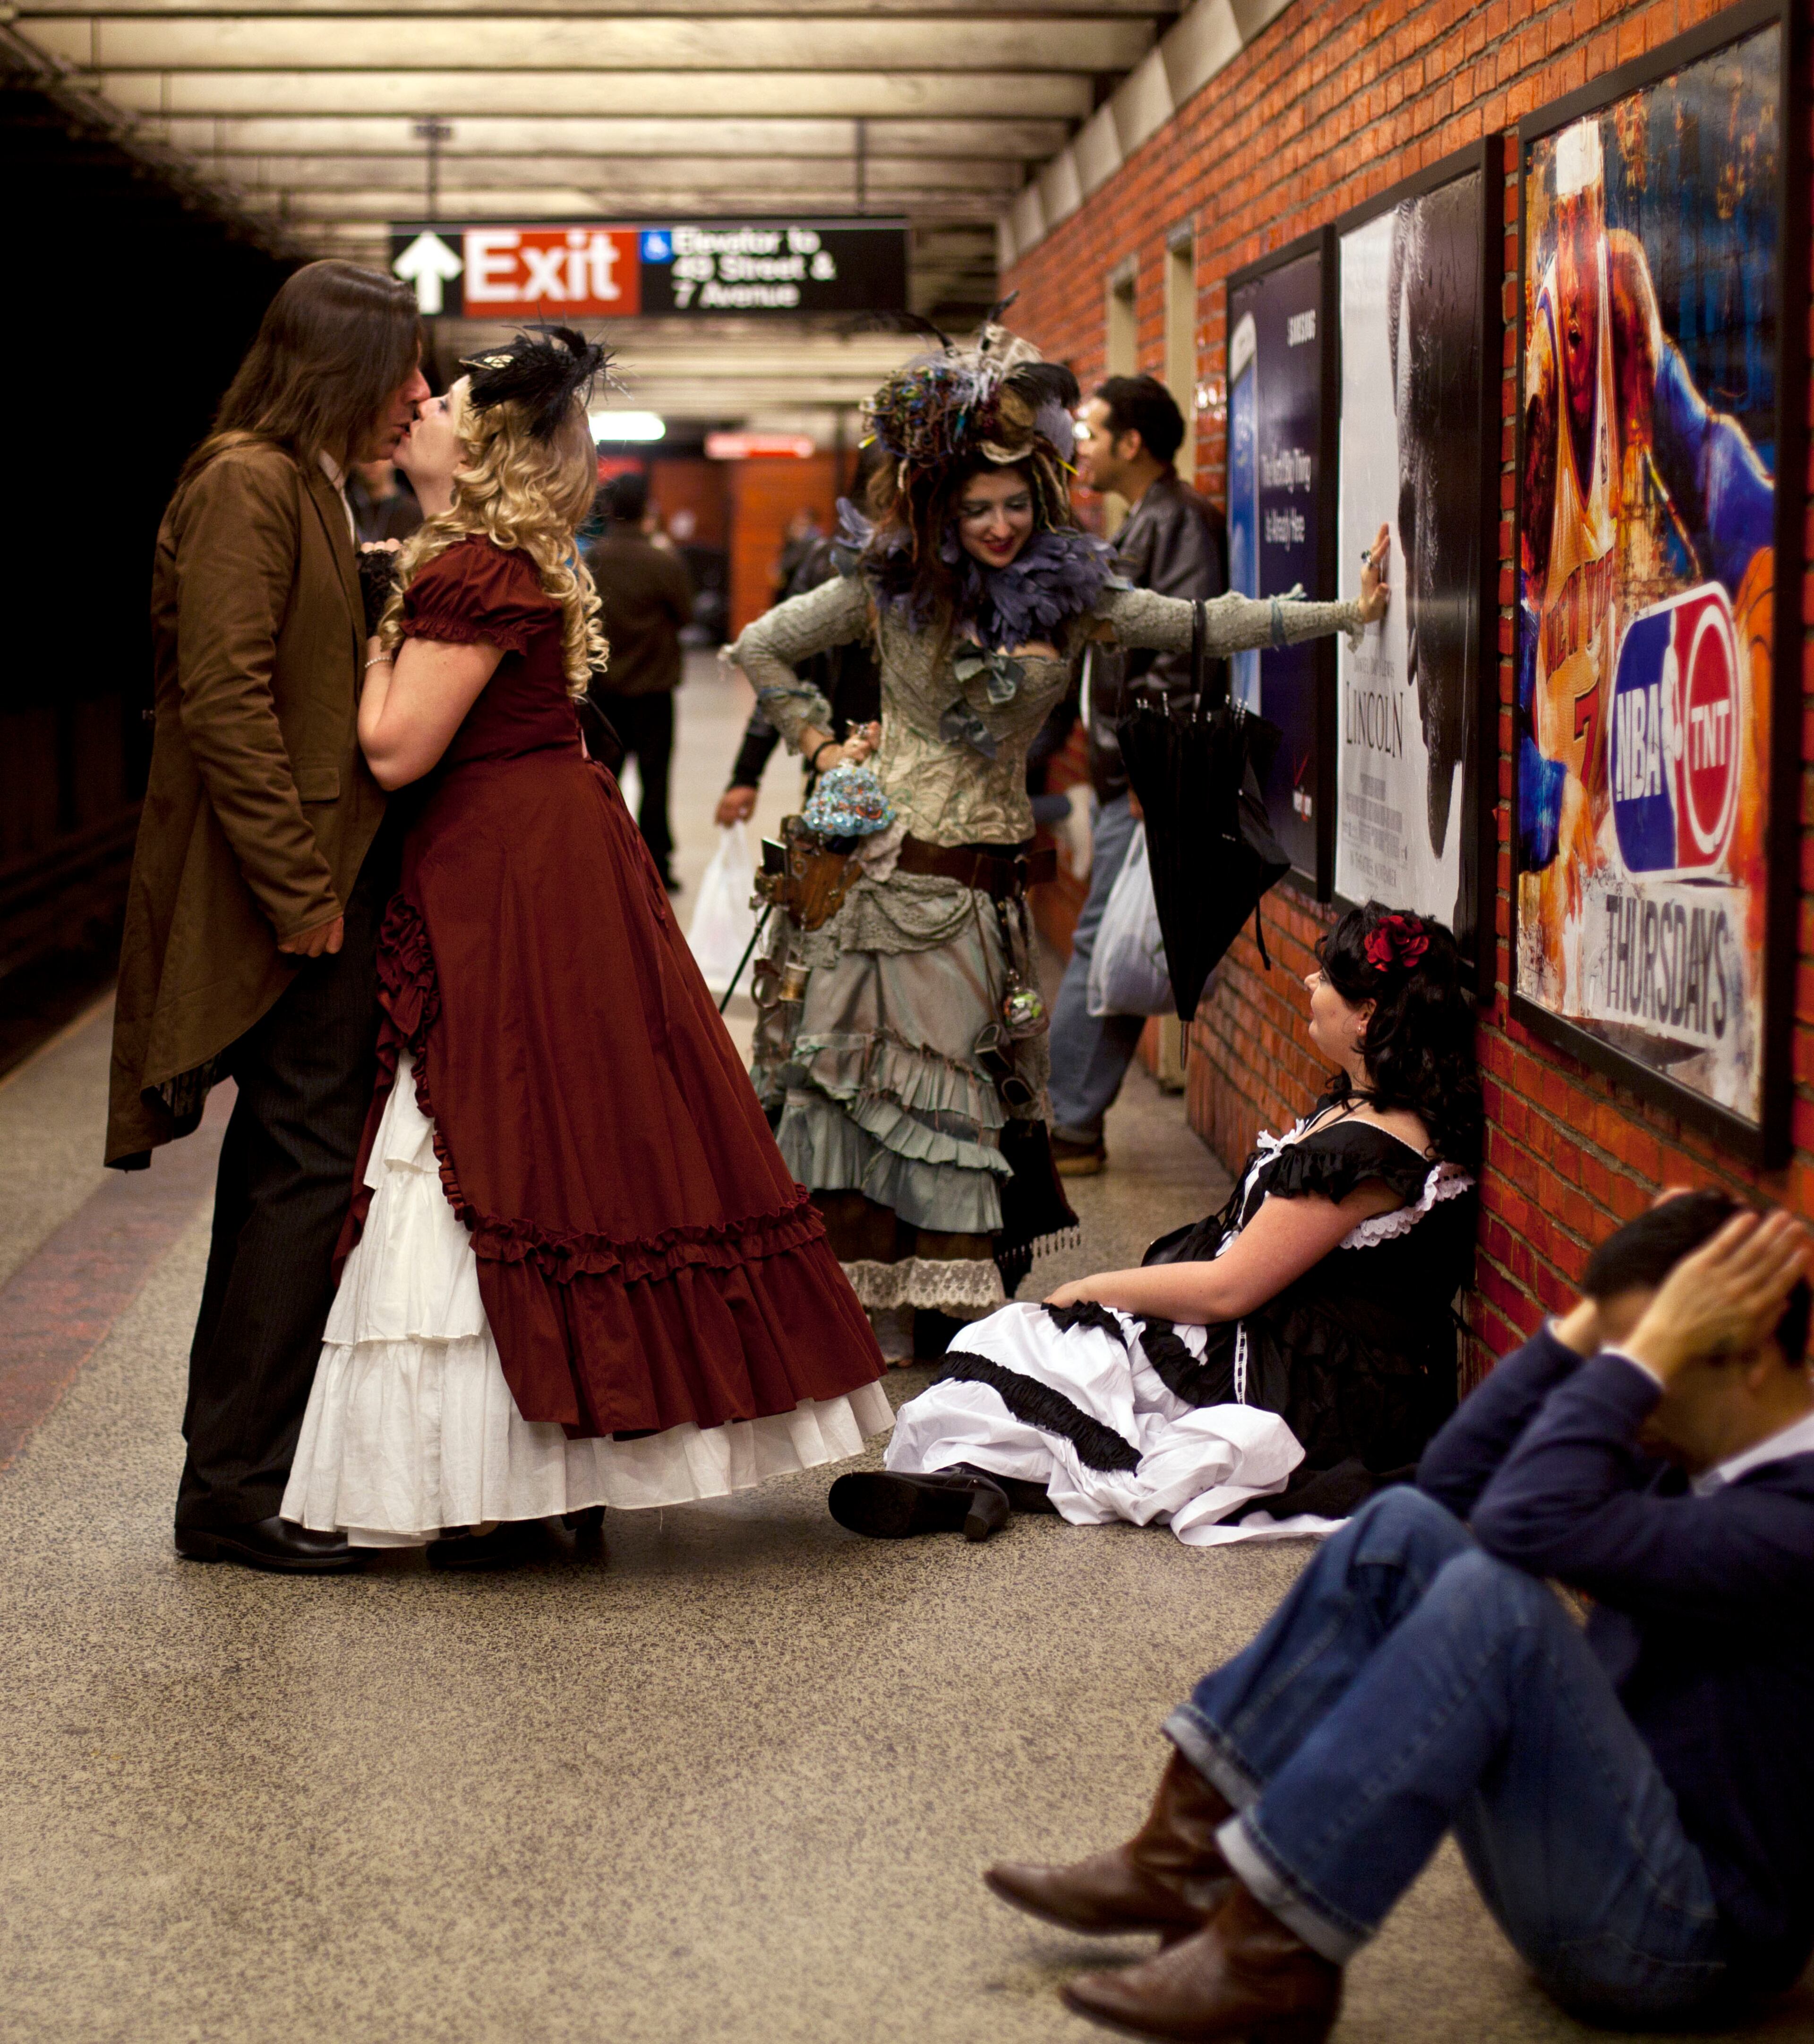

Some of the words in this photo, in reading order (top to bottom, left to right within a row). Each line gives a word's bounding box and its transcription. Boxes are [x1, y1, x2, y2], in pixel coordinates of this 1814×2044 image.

[465, 228, 621, 302] Exit
[671, 256, 715, 281] 49
[718, 255, 806, 281] Street
[809, 250, 836, 281] &
[672, 226, 782, 254] Elevator
[787, 226, 821, 254] to
[672, 280, 696, 308] 7
[698, 281, 801, 307] Avenue
[1584, 546, 1613, 647] YOR
[1346, 681, 1403, 759] LINCOLN
[1574, 675, 1600, 790] 7
[1616, 683, 1660, 802] NBA
[1691, 699, 1729, 771] TNT
[1606, 894, 1728, 1039] THURSDAYS
